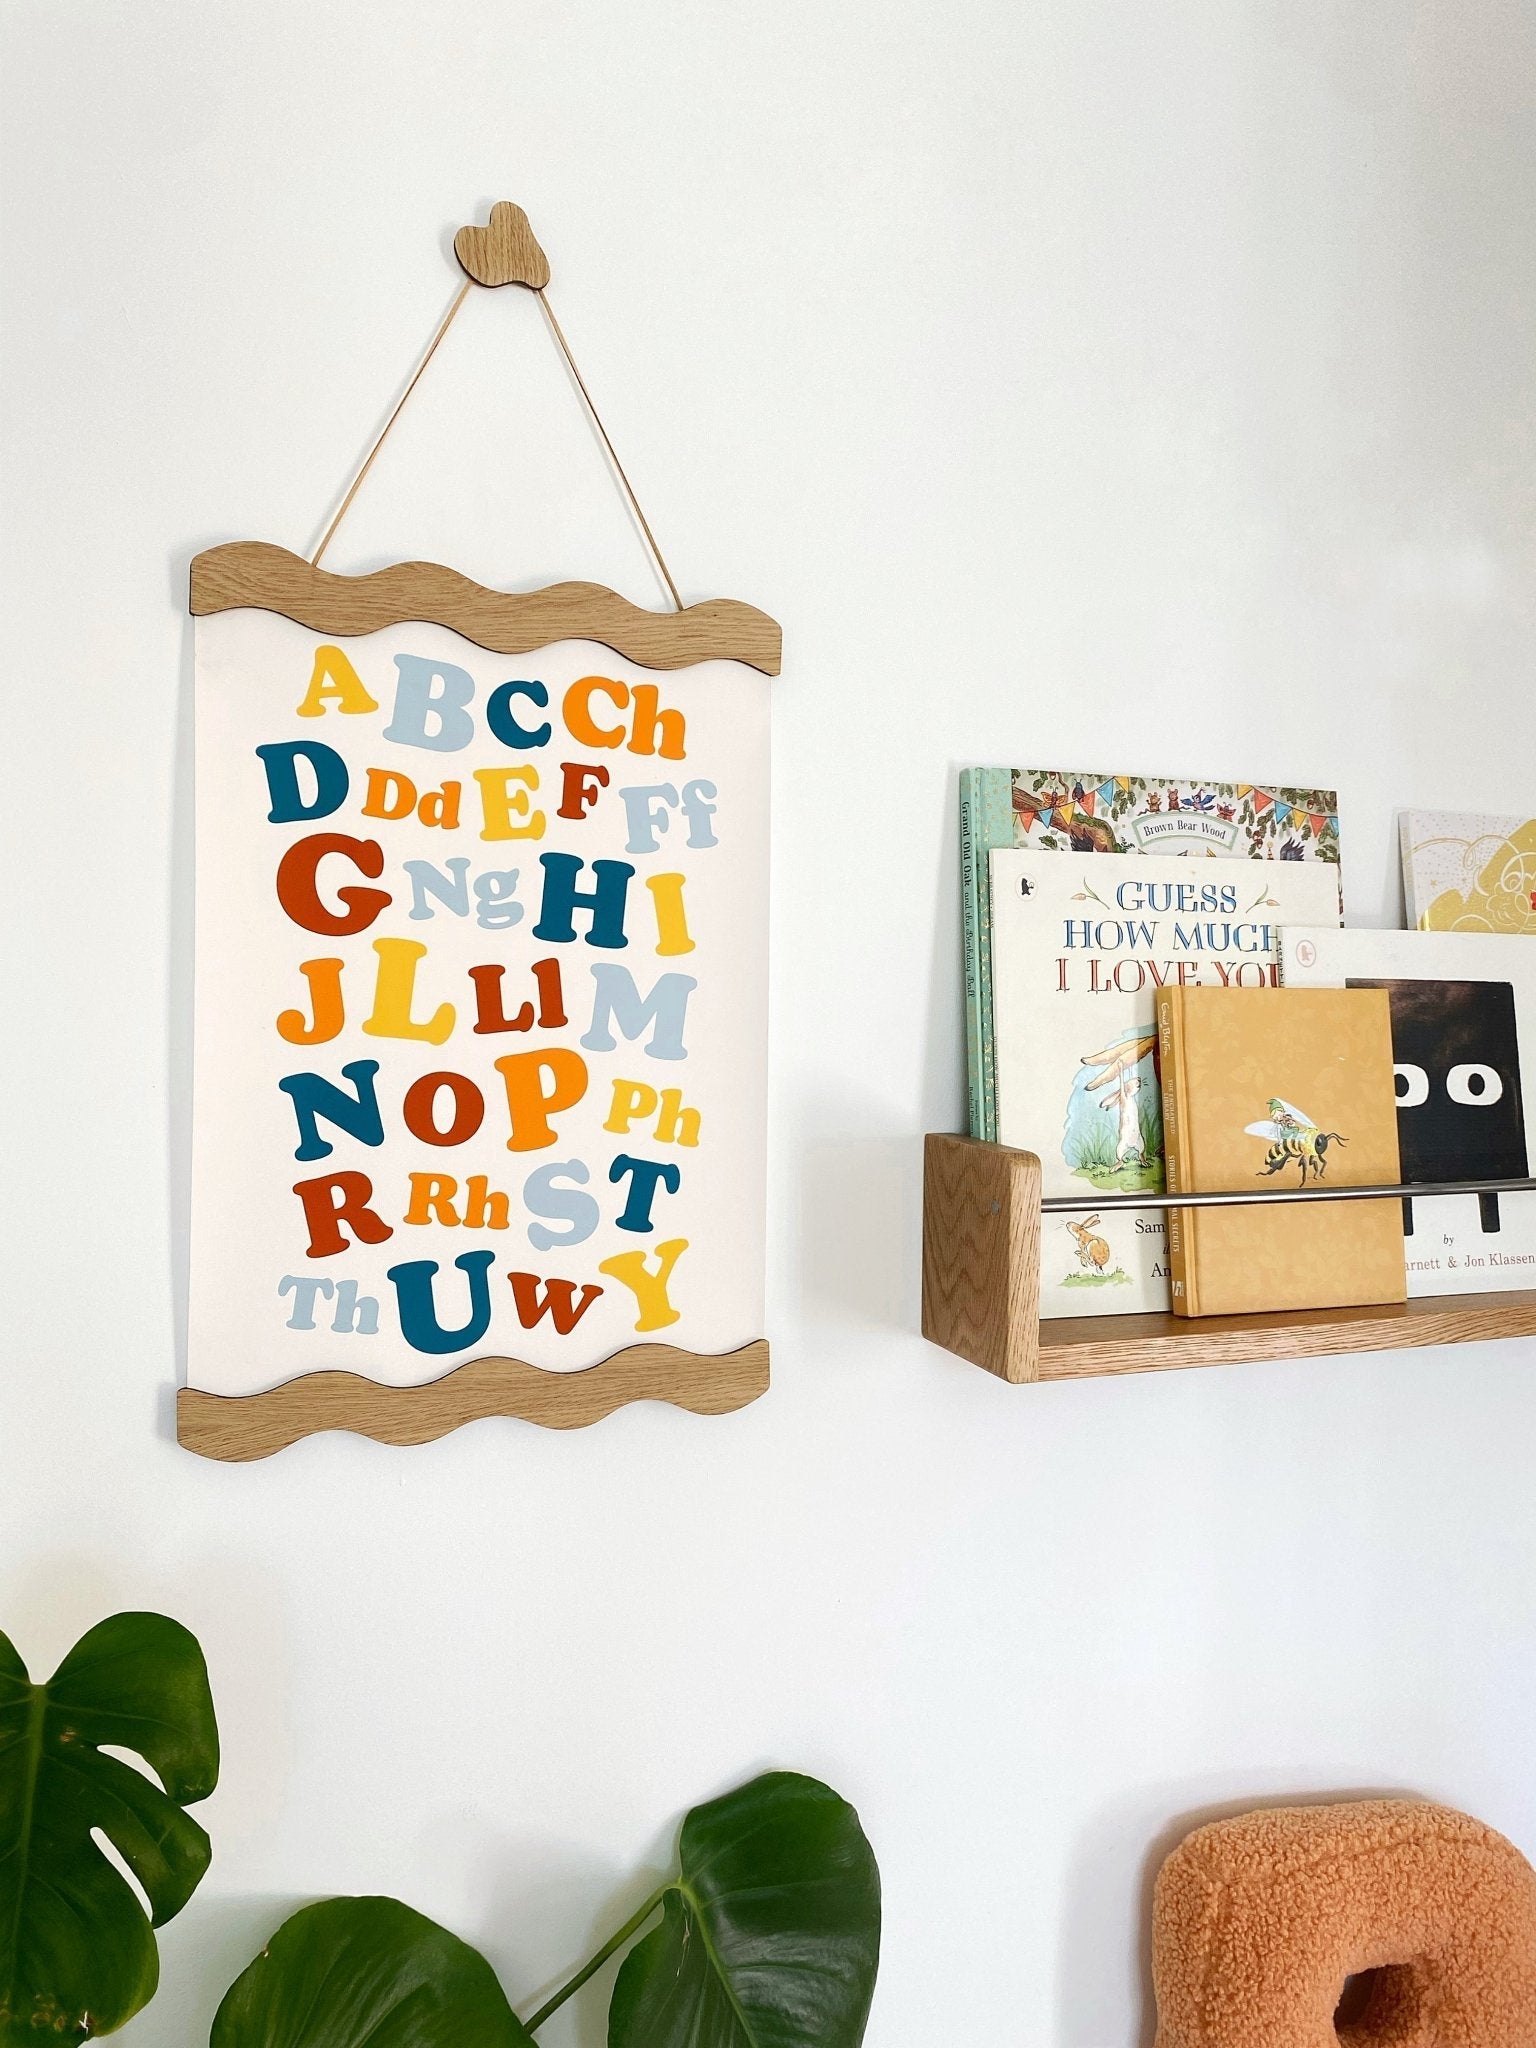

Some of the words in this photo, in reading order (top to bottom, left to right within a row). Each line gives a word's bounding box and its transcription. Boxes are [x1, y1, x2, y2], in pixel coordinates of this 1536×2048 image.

[297, 645, 379, 718] A
[382, 653, 476, 752] B
[486, 680, 552, 750] C
[562, 675, 687, 760] Ch
[256, 740, 349, 824] D
[361, 767, 461, 830] Dd
[472, 764, 546, 842] E
[556, 761, 610, 820] F
[619, 778, 719, 855] Ff
[961, 801, 970, 837] Grand
[1143, 822, 1174, 836] Brown
[1177, 820, 1198, 831] Bear
[1201, 822, 1227, 840] Wood
[962, 841, 971, 861] Old
[963, 865, 972, 887] Oak
[276, 832, 393, 937] G
[402, 857, 525, 930] Ng
[532, 852, 636, 949] H
[645, 872, 696, 957] I
[964, 892, 973, 910] and
[1116, 881, 1237, 913] GUESS
[965, 912, 974, 926] the
[1063, 919, 1160, 950] HOW
[965, 928, 974, 972] Birthday
[966, 974, 976, 998] Ball
[1055, 957, 1070, 993] I
[1087, 959, 1202, 994] LOVE
[276, 957, 346, 1046] J
[361, 937, 457, 1046] L
[579, 962, 699, 1061] M
[279, 1059, 386, 1162] N
[401, 1070, 486, 1147] O
[493, 1047, 589, 1153] P
[602, 1078, 702, 1148] Ph
[1168, 1093, 1176, 1135] ENCHANTED
[1168, 1155, 1176, 1182] STORIES
[292, 1170, 394, 1259] R
[402, 1172, 511, 1231] Rh
[522, 1158, 600, 1252] S
[609, 1154, 681, 1233] T
[1135, 1218, 1166, 1234] Sam
[1171, 1223, 1179, 1252] SECRETS
[1443, 1234, 1455, 1246] by
[1404, 1257, 1441, 1271] arnett
[1447, 1256, 1458, 1269] &
[1464, 1254, 1485, 1268] Jon
[1488, 1253, 1536, 1266] Klassen
[277, 1274, 380, 1335] Th
[387, 1250, 495, 1355] U
[506, 1271, 604, 1336] W
[598, 1237, 690, 1333] Y
